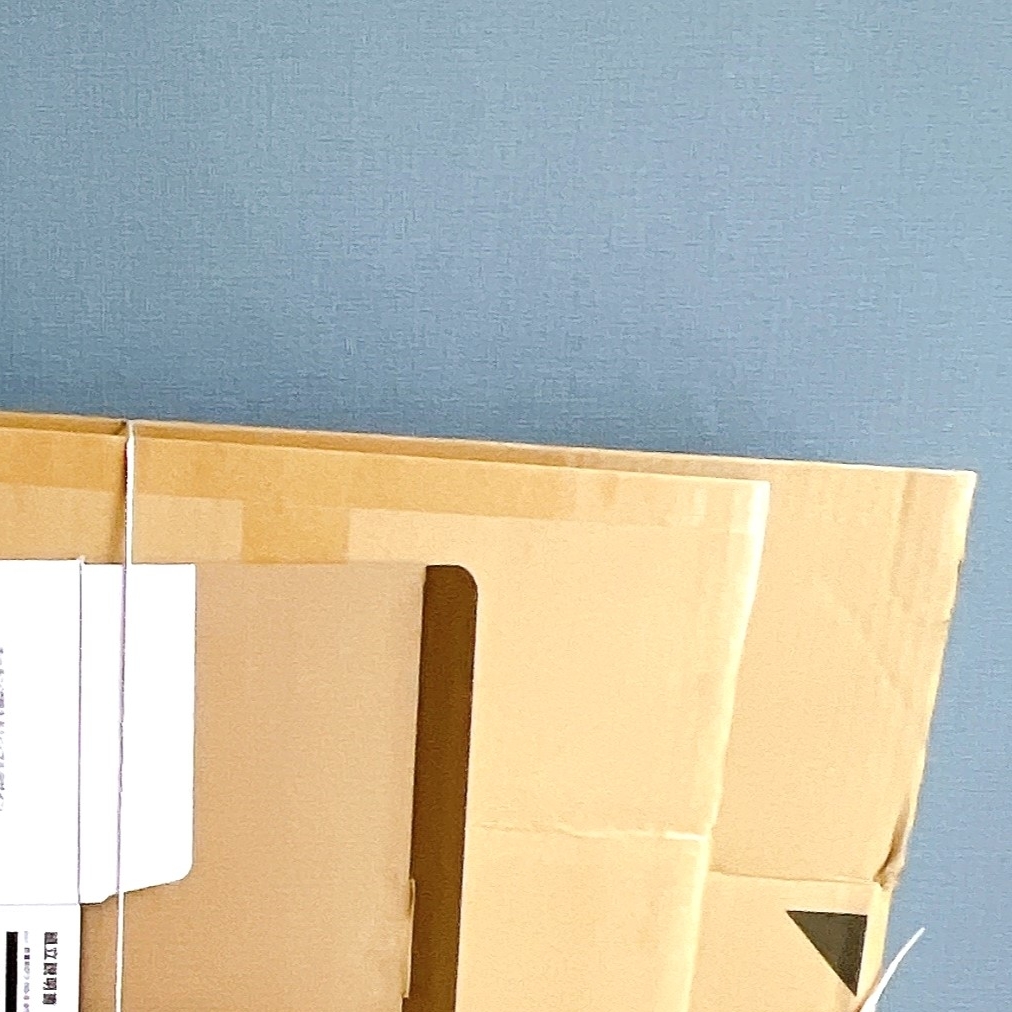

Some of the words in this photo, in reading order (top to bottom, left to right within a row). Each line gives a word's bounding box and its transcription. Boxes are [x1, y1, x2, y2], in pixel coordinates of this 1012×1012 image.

[42, 931, 58, 1005] 組立説明書
